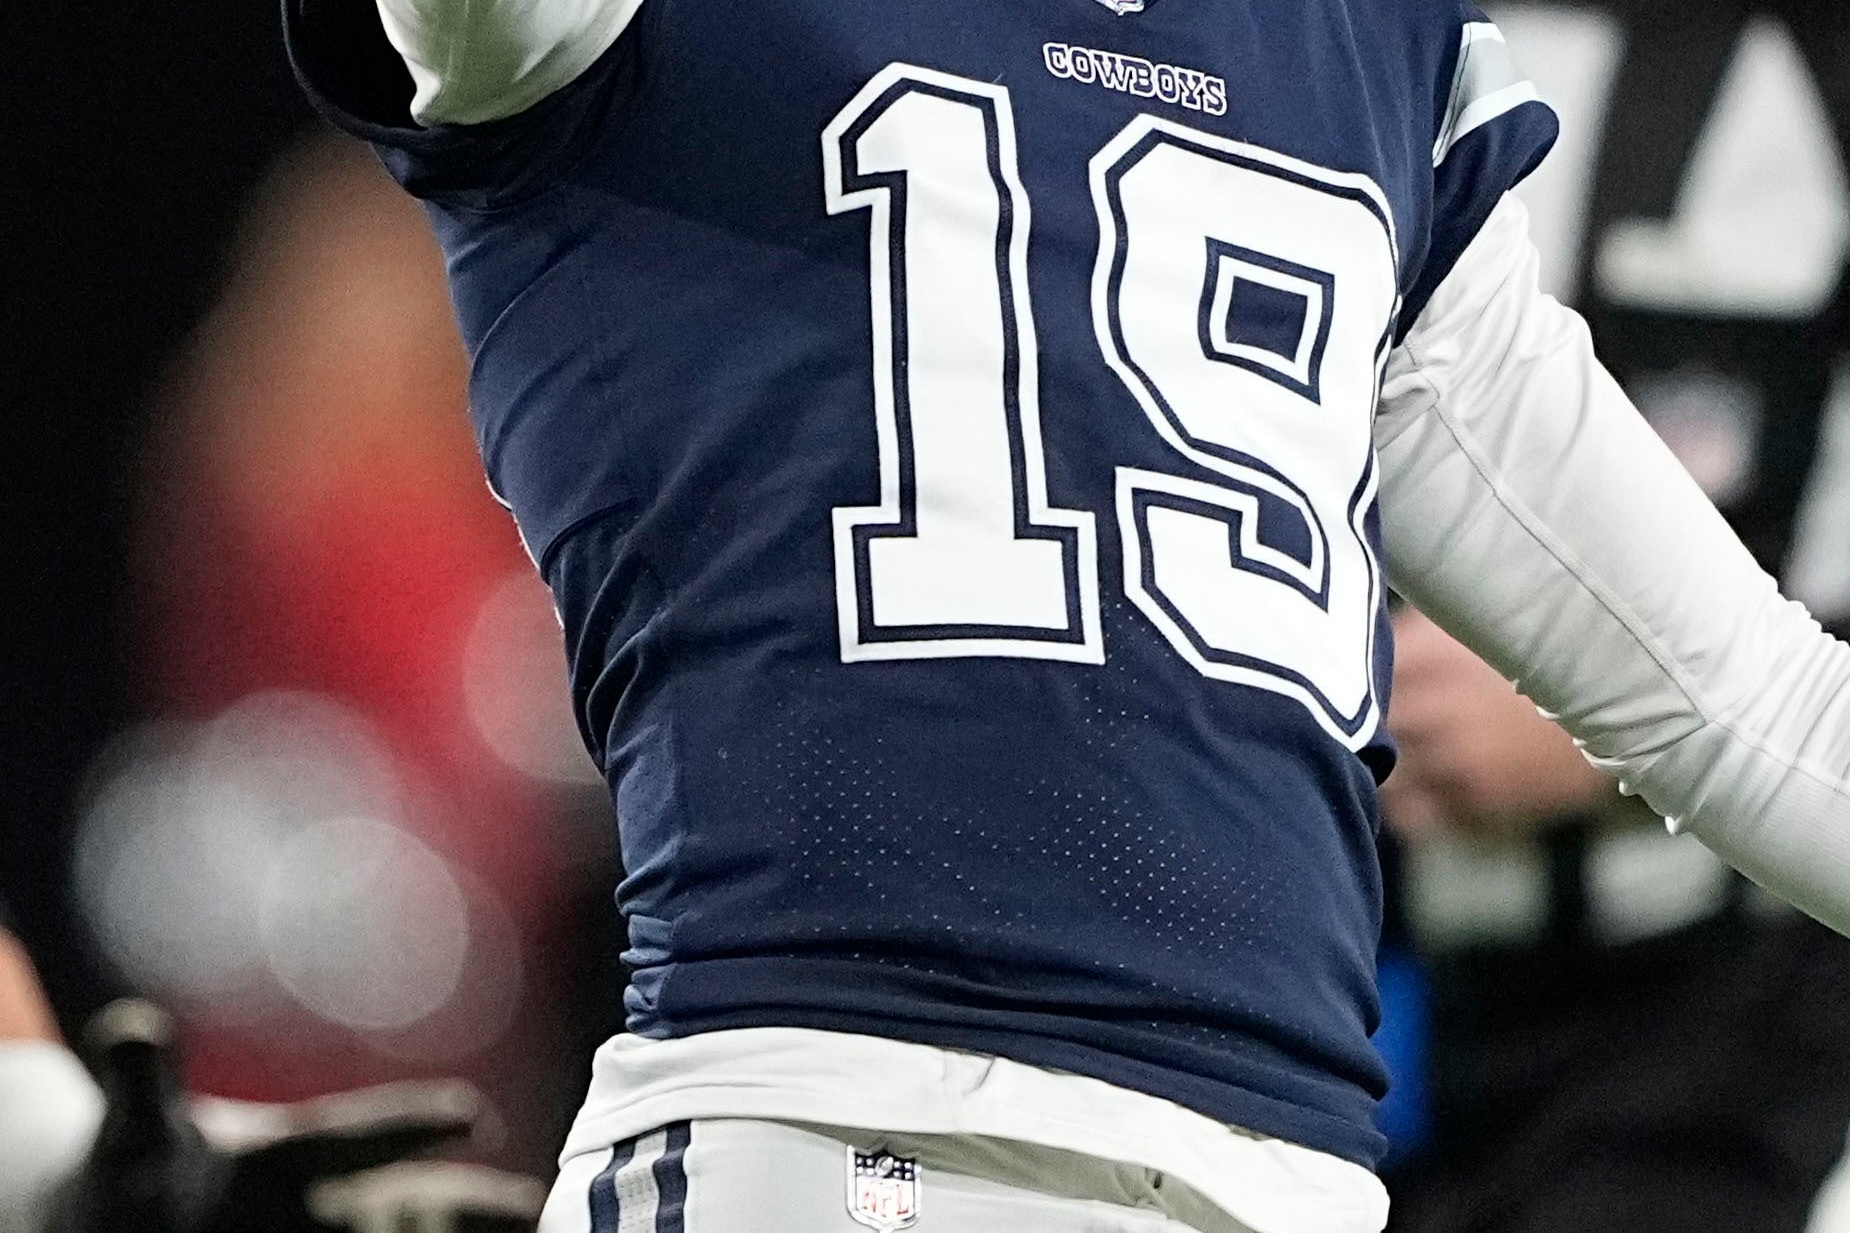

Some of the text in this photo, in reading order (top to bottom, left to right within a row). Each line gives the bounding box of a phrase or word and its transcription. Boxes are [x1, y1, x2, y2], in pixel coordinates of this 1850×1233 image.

[1043, 42, 1227, 115] COWBOYS
[821, 61, 1402, 752] 19
[861, 1181, 909, 1218] NFL
